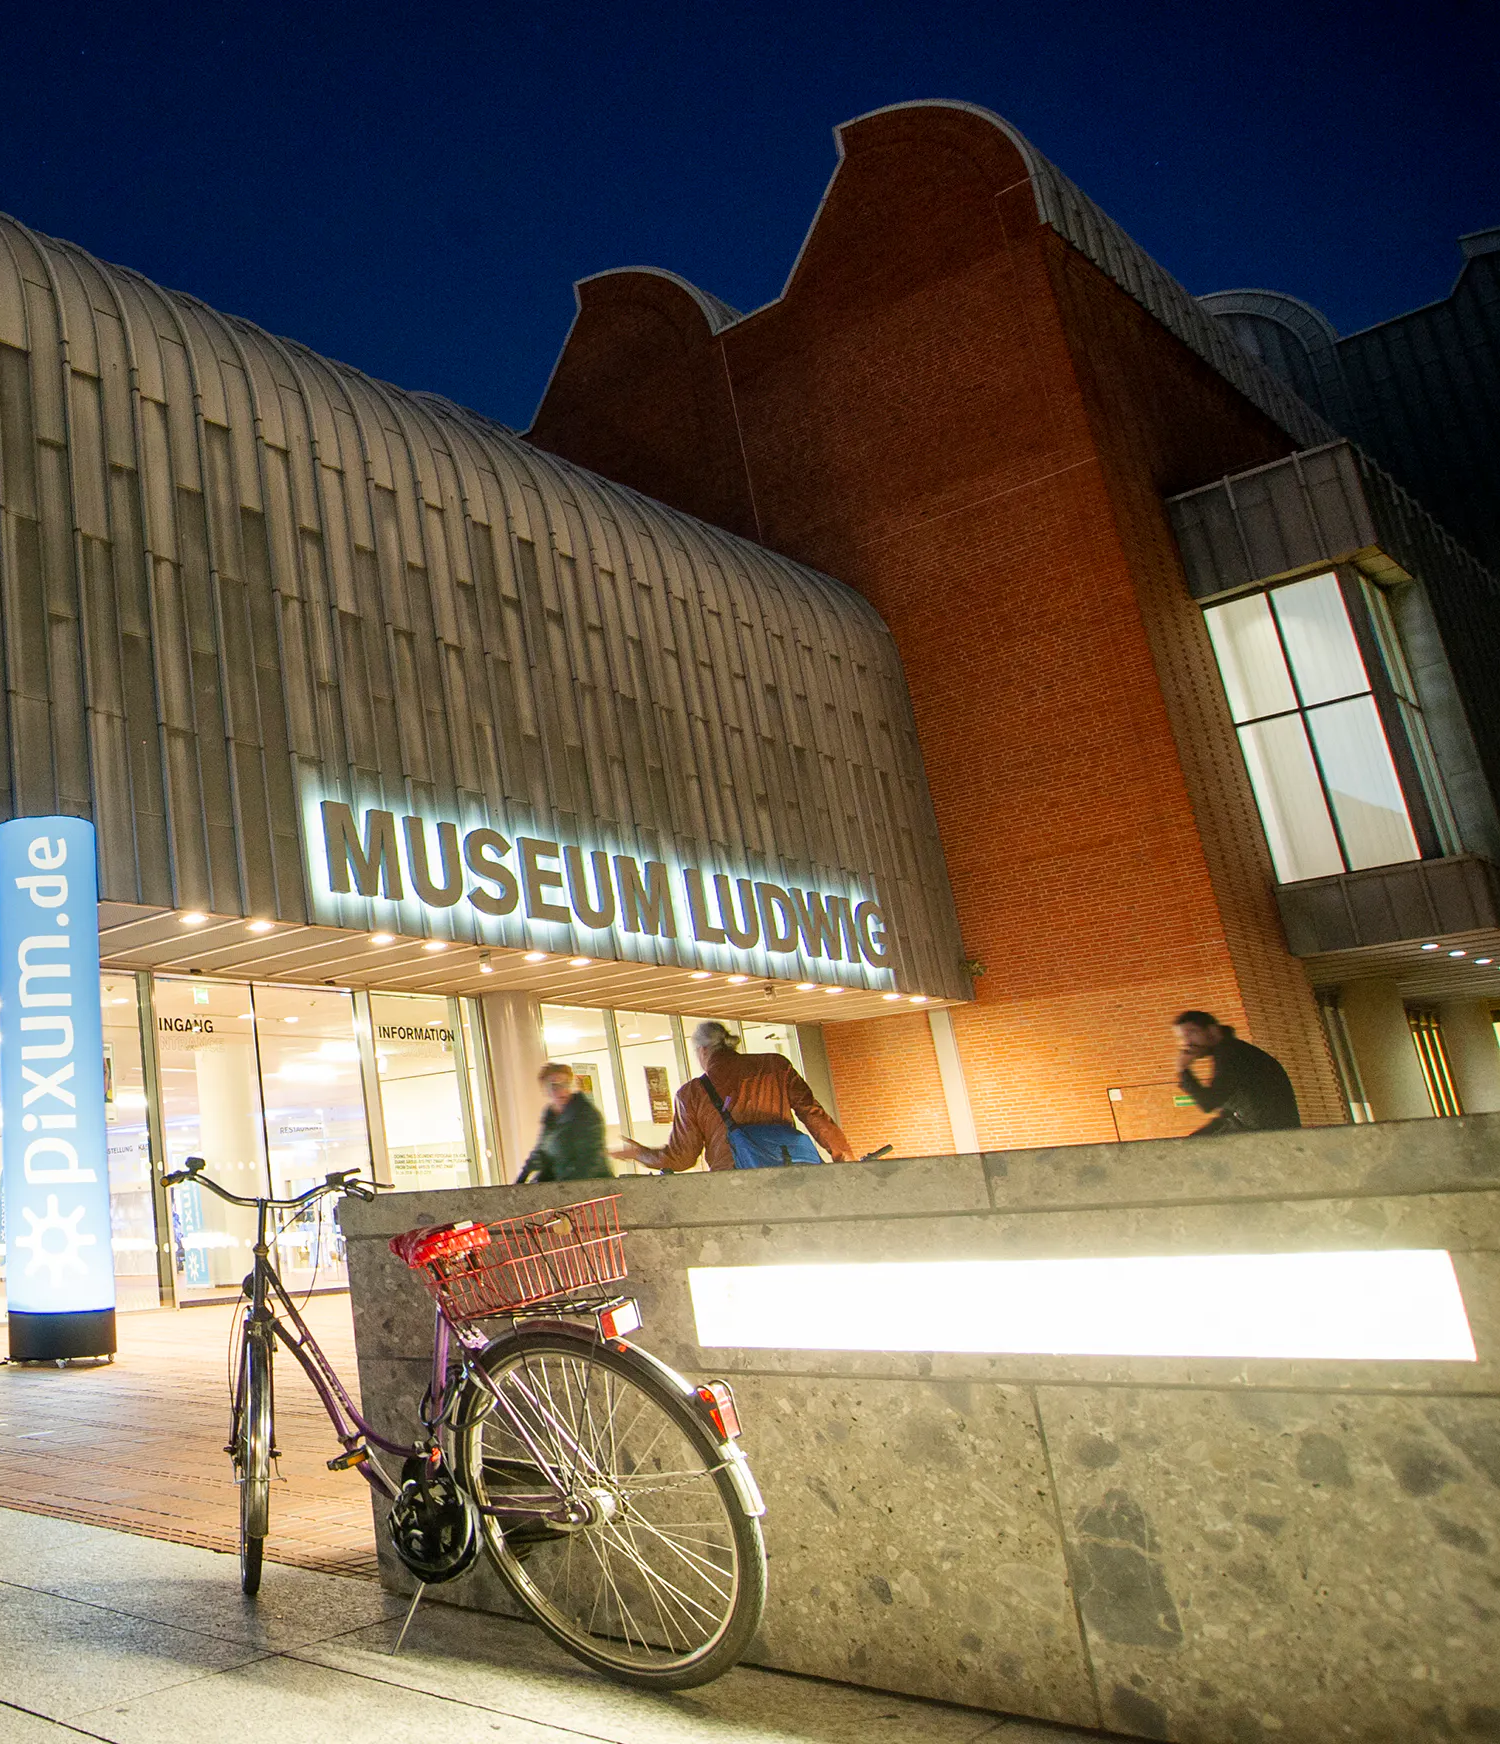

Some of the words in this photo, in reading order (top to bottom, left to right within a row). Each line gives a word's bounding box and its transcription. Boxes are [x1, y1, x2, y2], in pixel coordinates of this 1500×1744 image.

[320, 800, 678, 939] MUSEUM
[683, 868, 891, 969] LUDWIG
[15, 836, 98, 1185] pixum.de
[158, 1017, 214, 1033] INGANG
[378, 1026, 455, 1041] INFORMATION
